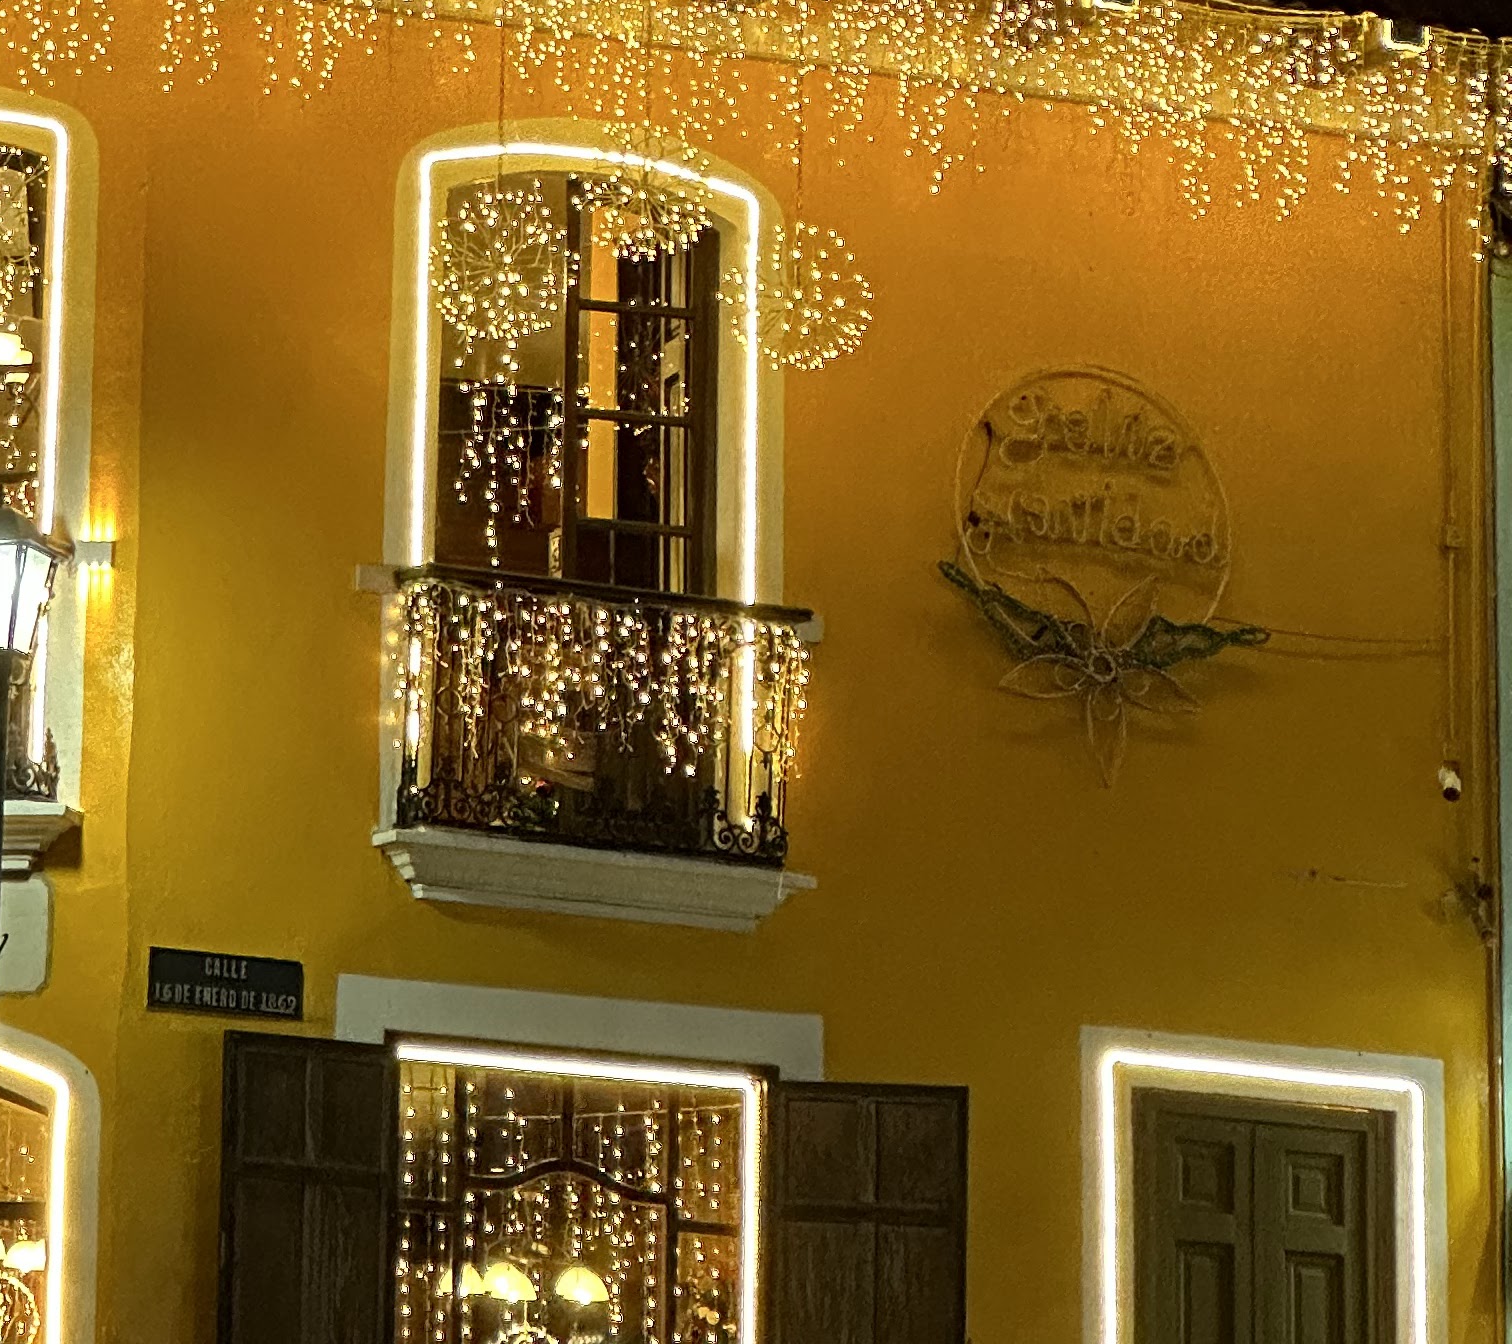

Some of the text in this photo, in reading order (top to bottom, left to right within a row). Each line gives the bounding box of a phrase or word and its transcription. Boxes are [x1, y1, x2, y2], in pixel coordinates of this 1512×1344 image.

[205, 957, 248, 979] CALLE
[155, 982, 172, 1002] 16
[174, 984, 191, 1004] DE
[195, 985, 237, 1008] ENERO
[241, 990, 256, 1010] DE
